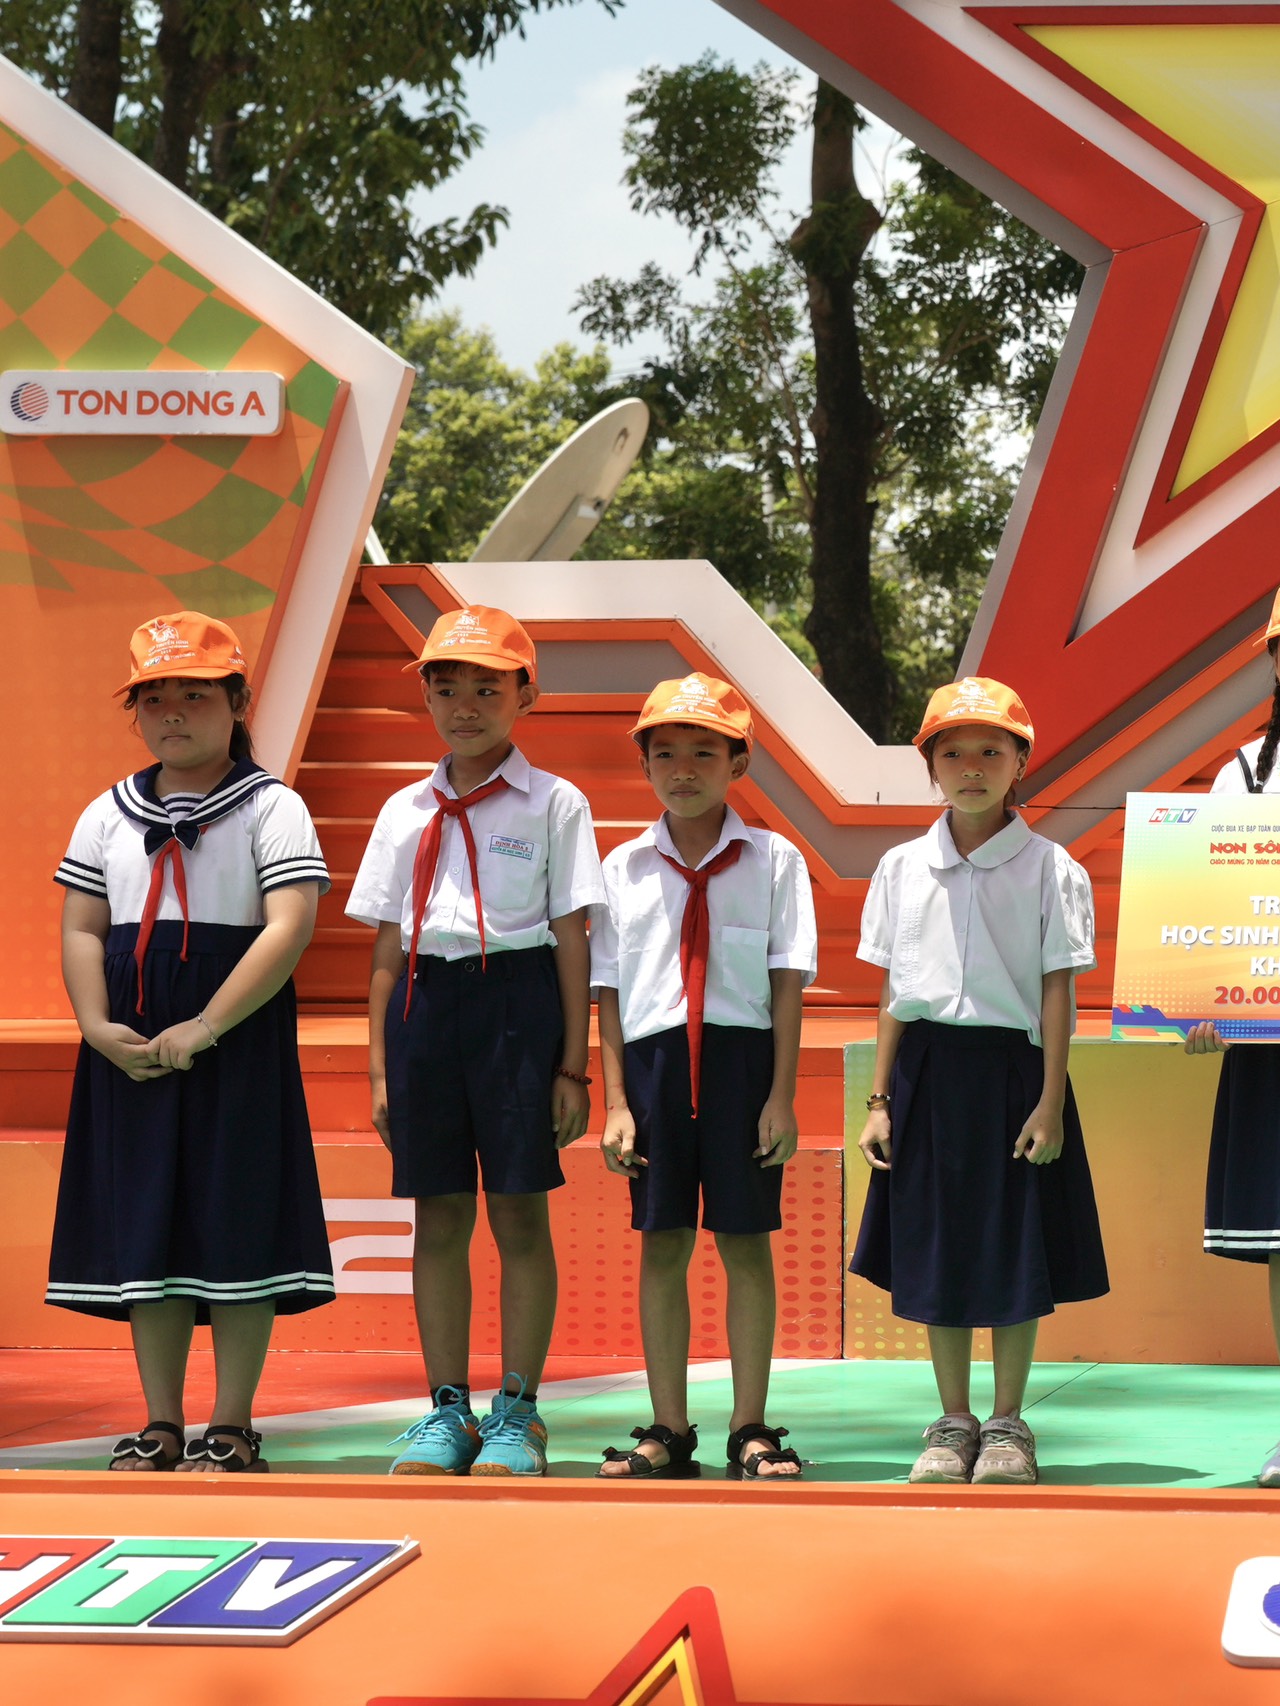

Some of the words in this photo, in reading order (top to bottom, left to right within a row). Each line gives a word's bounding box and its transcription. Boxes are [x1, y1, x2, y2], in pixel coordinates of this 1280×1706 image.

[57, 390, 127, 415] TON
[136, 390, 235, 416] DONG
[240, 391, 266, 416] A
[1148, 807, 1199, 824] HTV
[1210, 842, 1247, 854] NON
[1161, 925, 1214, 950] HỌC
[1220, 925, 1279, 945] SINH
